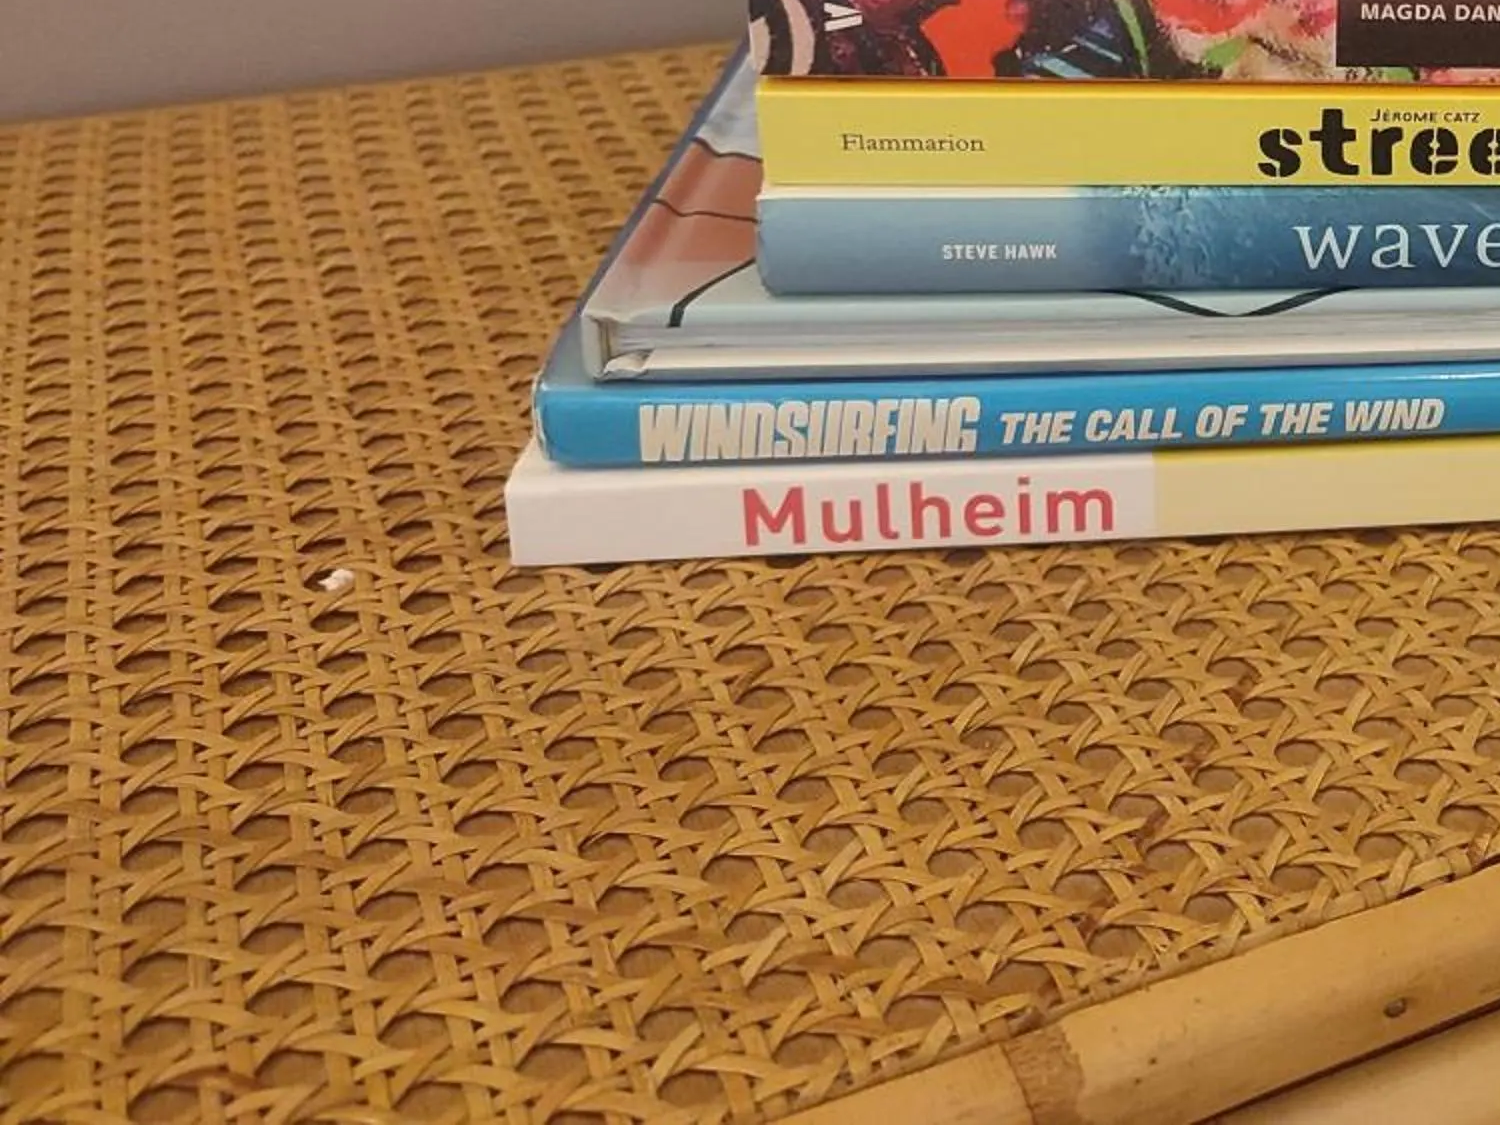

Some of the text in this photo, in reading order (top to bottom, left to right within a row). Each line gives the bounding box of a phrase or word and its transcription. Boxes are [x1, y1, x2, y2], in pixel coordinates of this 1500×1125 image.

[1361, 2, 1447, 22] MAGDA
[1443, 112, 1480, 123] CATZ
[842, 132, 985, 153] Flammarion
[942, 243, 1057, 261] STEVE HAWK
[639, 396, 1446, 463] WINDSURFING THE CALL OF THE WIND
[743, 477, 1115, 547] Mulheim
